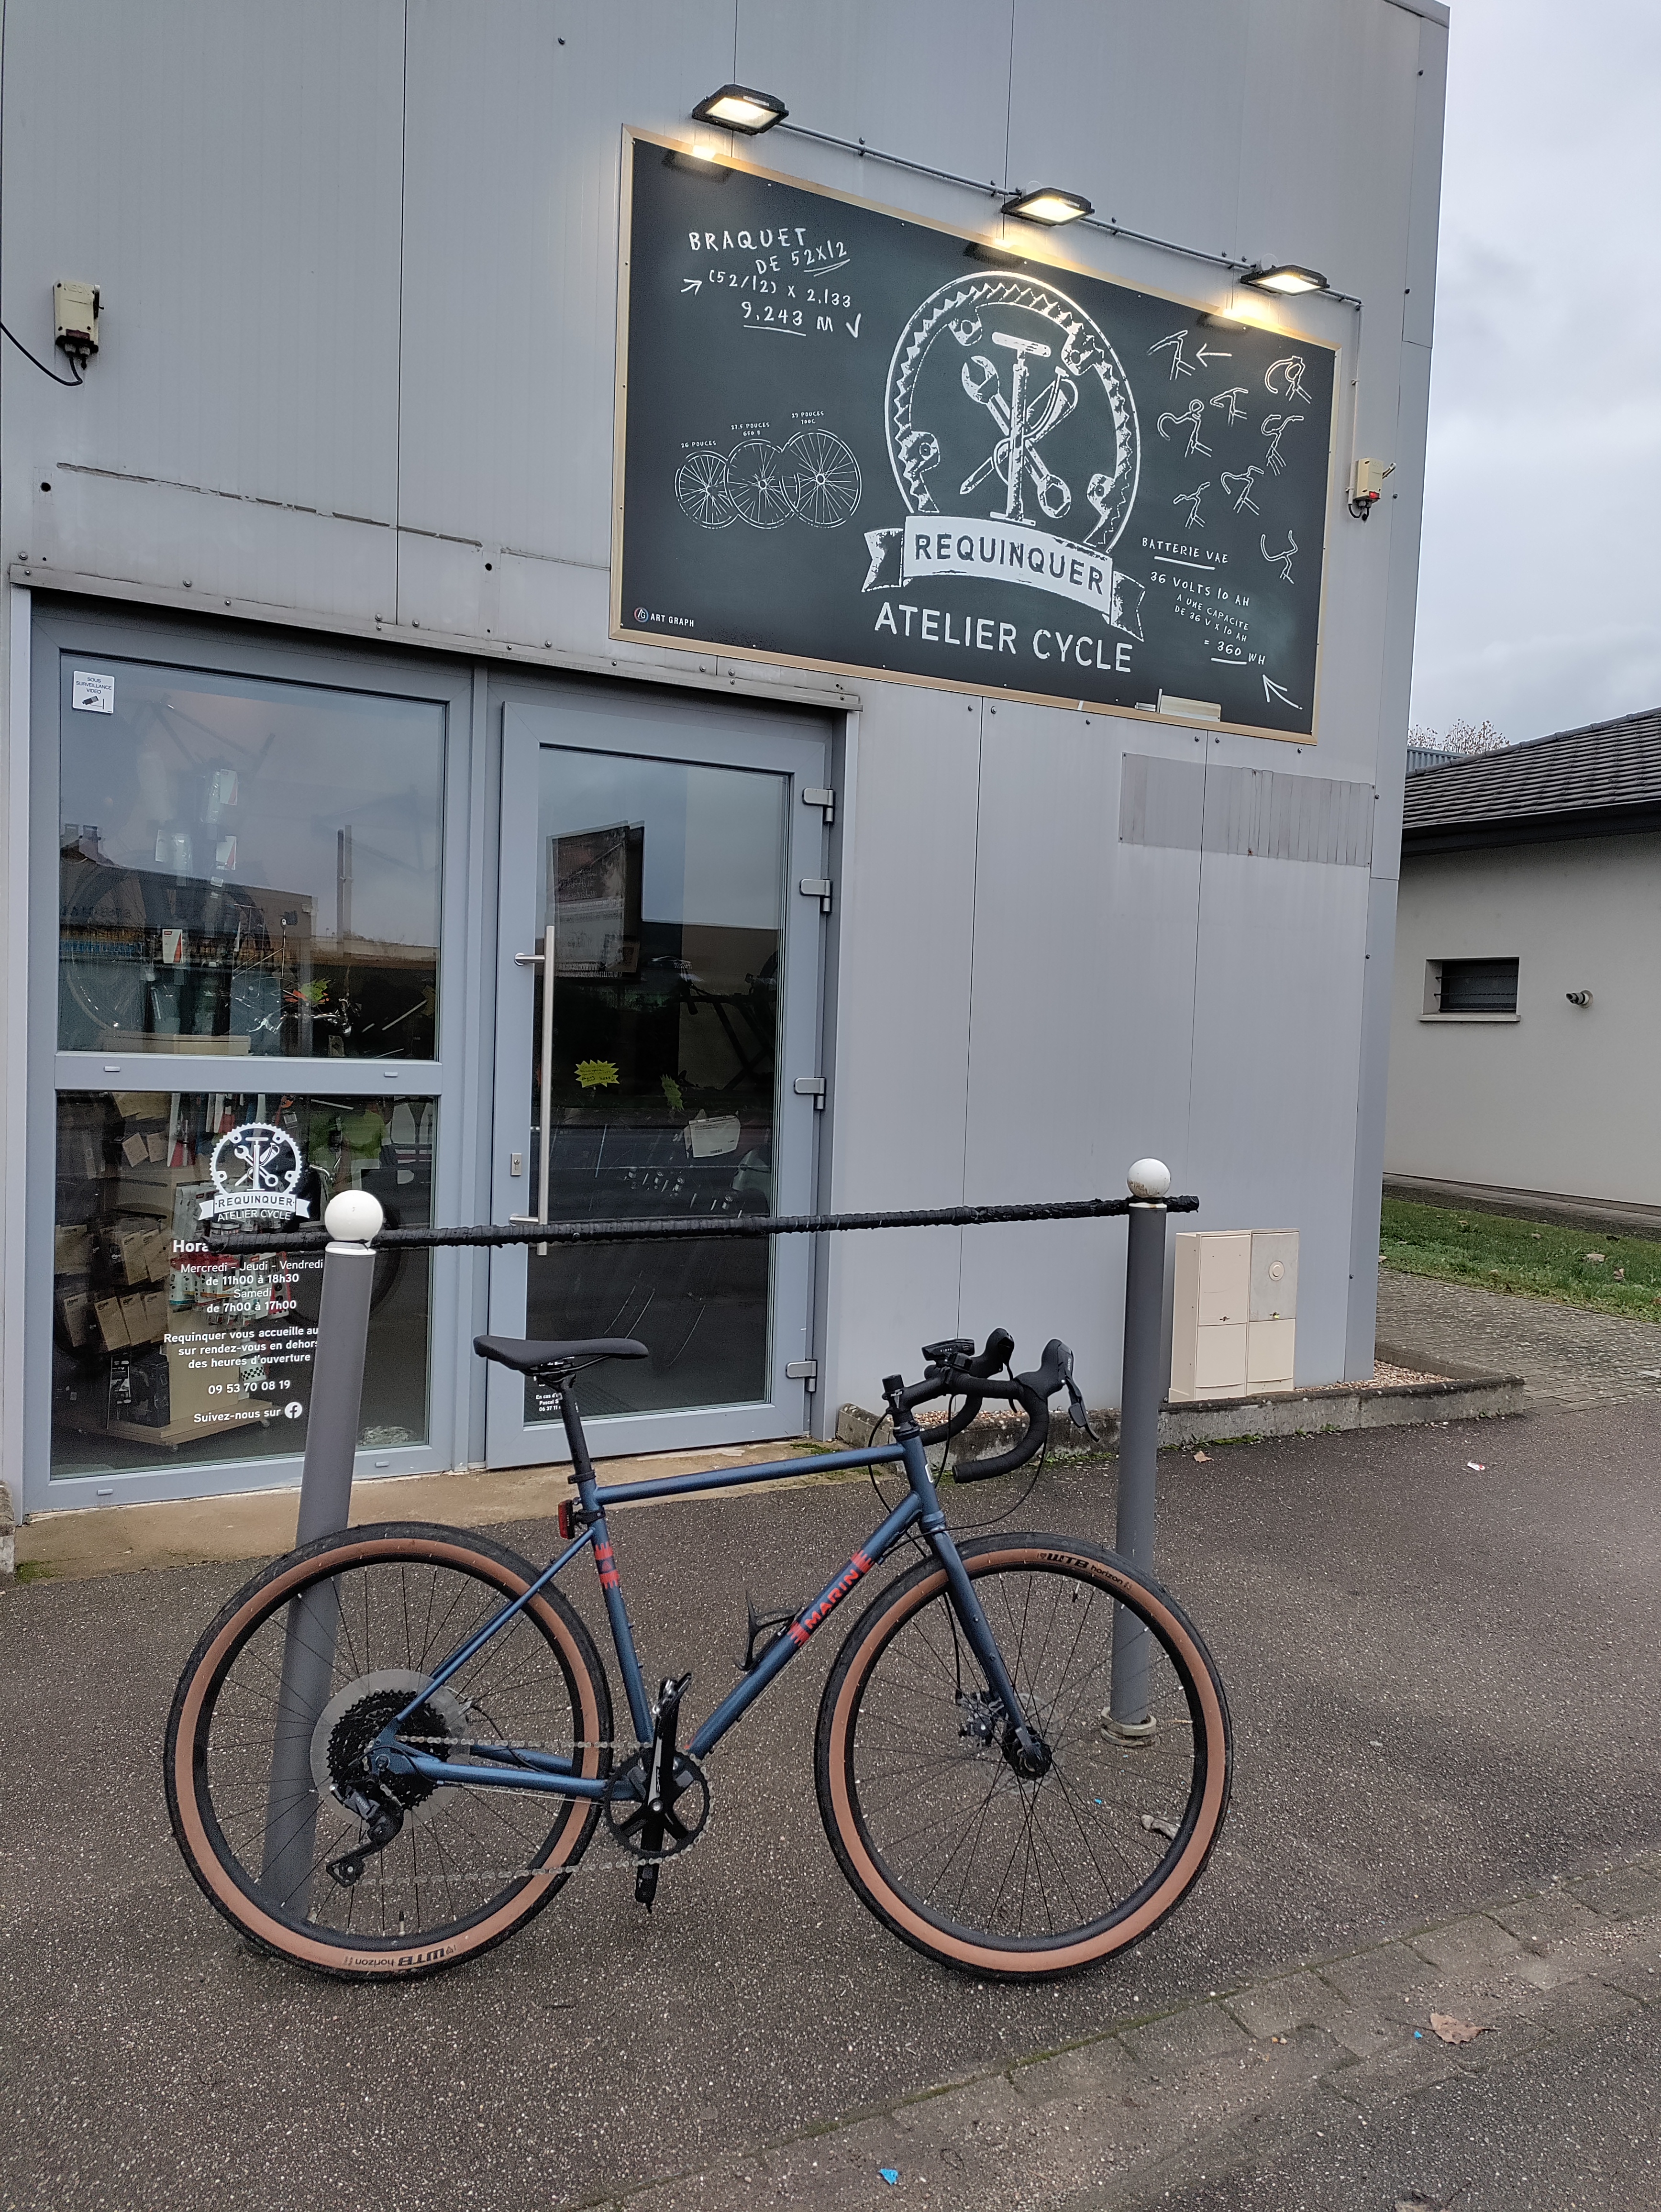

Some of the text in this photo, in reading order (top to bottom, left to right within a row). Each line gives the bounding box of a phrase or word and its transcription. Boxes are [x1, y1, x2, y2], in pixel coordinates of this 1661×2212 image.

[689, 227, 806, 251] BRAQUET
[755, 255, 781, 274] DE
[1142, 537, 1228, 564] BATTERIE VAE
[915, 533, 1104, 595] REQUINQUER
[1151, 572, 1250, 607] 36 VOLTS 10 AH
[1186, 598, 1203, 611] UNE
[650, 613, 665, 622] ART
[668, 616, 694, 627] GRAPH
[1174, 605, 1185, 616] DE
[1189, 612, 1201, 622] 36
[1223, 626, 1232, 635] 10
[1236, 632, 1247, 642] AH
[875, 602, 1133, 672] ATELIER CYCLE
[1217, 641, 1241, 656] 360
[1248, 653, 1266, 665] WH
[76, 681, 112, 690] SURVEILLANCE
[218, 1195, 292, 1208] REQUINQUER
[217, 1209, 291, 1222] ATELIER CYCLE
[181, 1262, 227, 1273] Mercredi
[239, 1261, 268, 1271] Jeudi
[280, 1260, 324, 1270] Vendredi
[206, 1273, 299, 1286] de 11h00 à 18h30
[233, 1288, 272, 1298] Samedi
[207, 1300, 297, 1313] de 7h00 à 17h00
[164, 1331, 226, 1344] Requinquer
[230, 1330, 255, 1339] vous
[258, 1327, 303, 1338] accueille
[178, 1347, 196, 1356] sur
[200, 1343, 266, 1355] rendez-vous
[188, 1359, 208, 1369] des
[211, 1357, 247, 1368] heures
[208, 1380, 290, 1394] 09 53 70 08 19
[193, 1411, 260, 1423] Suivez-nous
[264, 1408, 281, 1417] sur
[1047, 1553, 1124, 1585] WTB horizon
[804, 1569, 859, 1629] MARIN
[354, 1947, 445, 1967] WTB horizon
